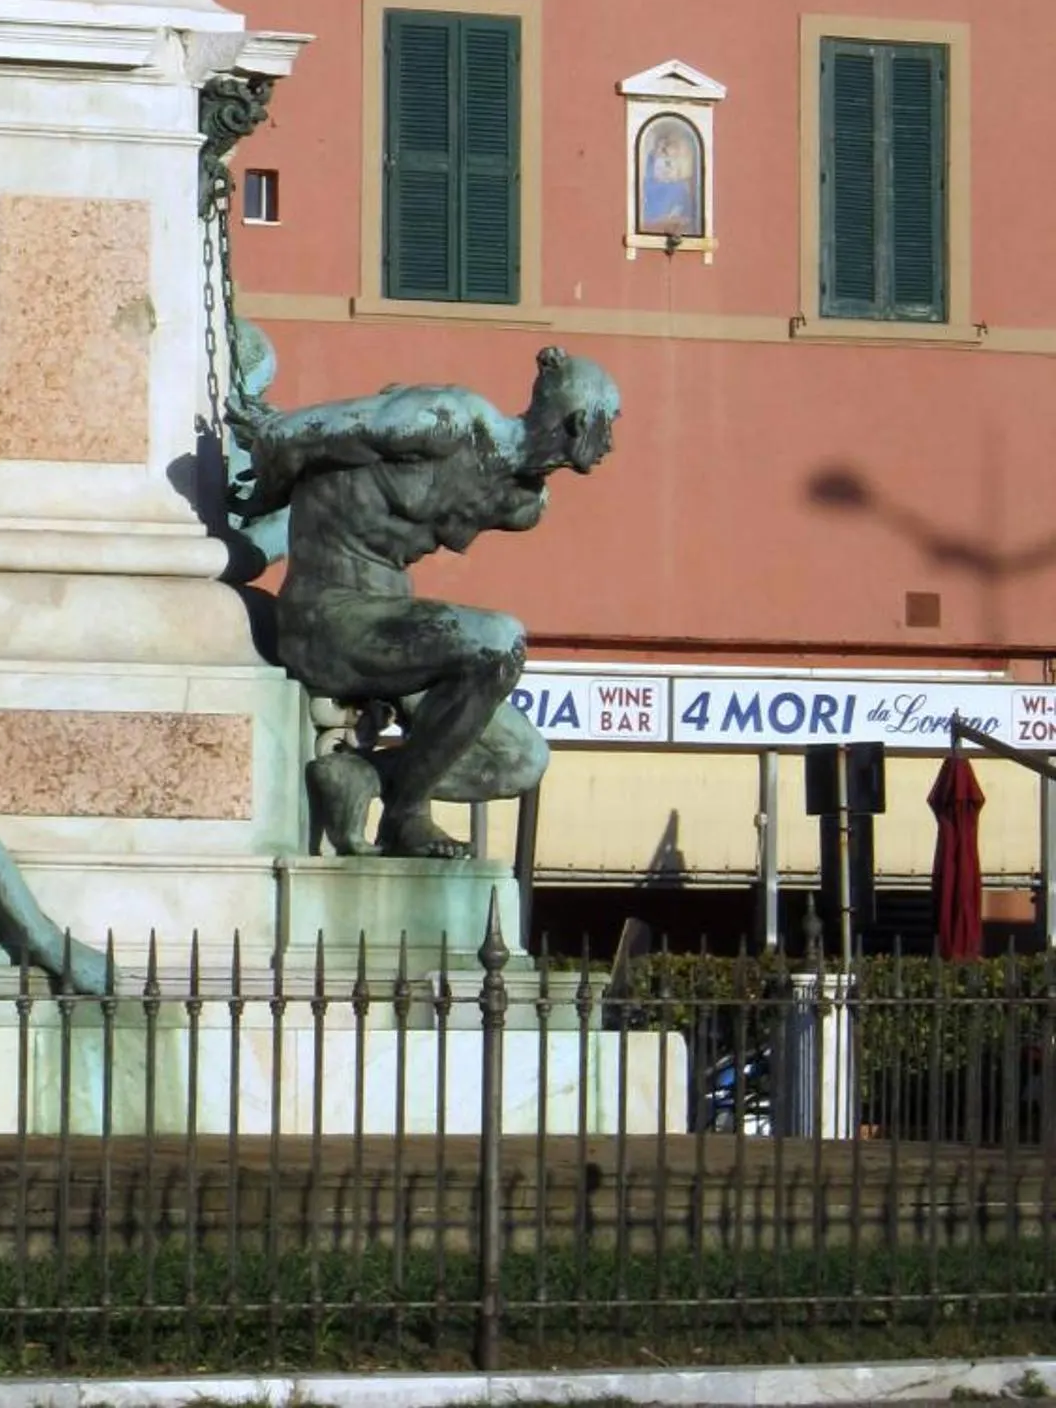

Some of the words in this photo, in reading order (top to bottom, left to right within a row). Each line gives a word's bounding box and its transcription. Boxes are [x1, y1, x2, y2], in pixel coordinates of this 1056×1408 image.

[598, 686, 653, 708] WINE
[1021, 695, 1056, 716] WI-
[600, 711, 652, 732] BAR
[680, 691, 711, 731] 4
[719, 691, 857, 734] MORI
[866, 699, 891, 722] da
